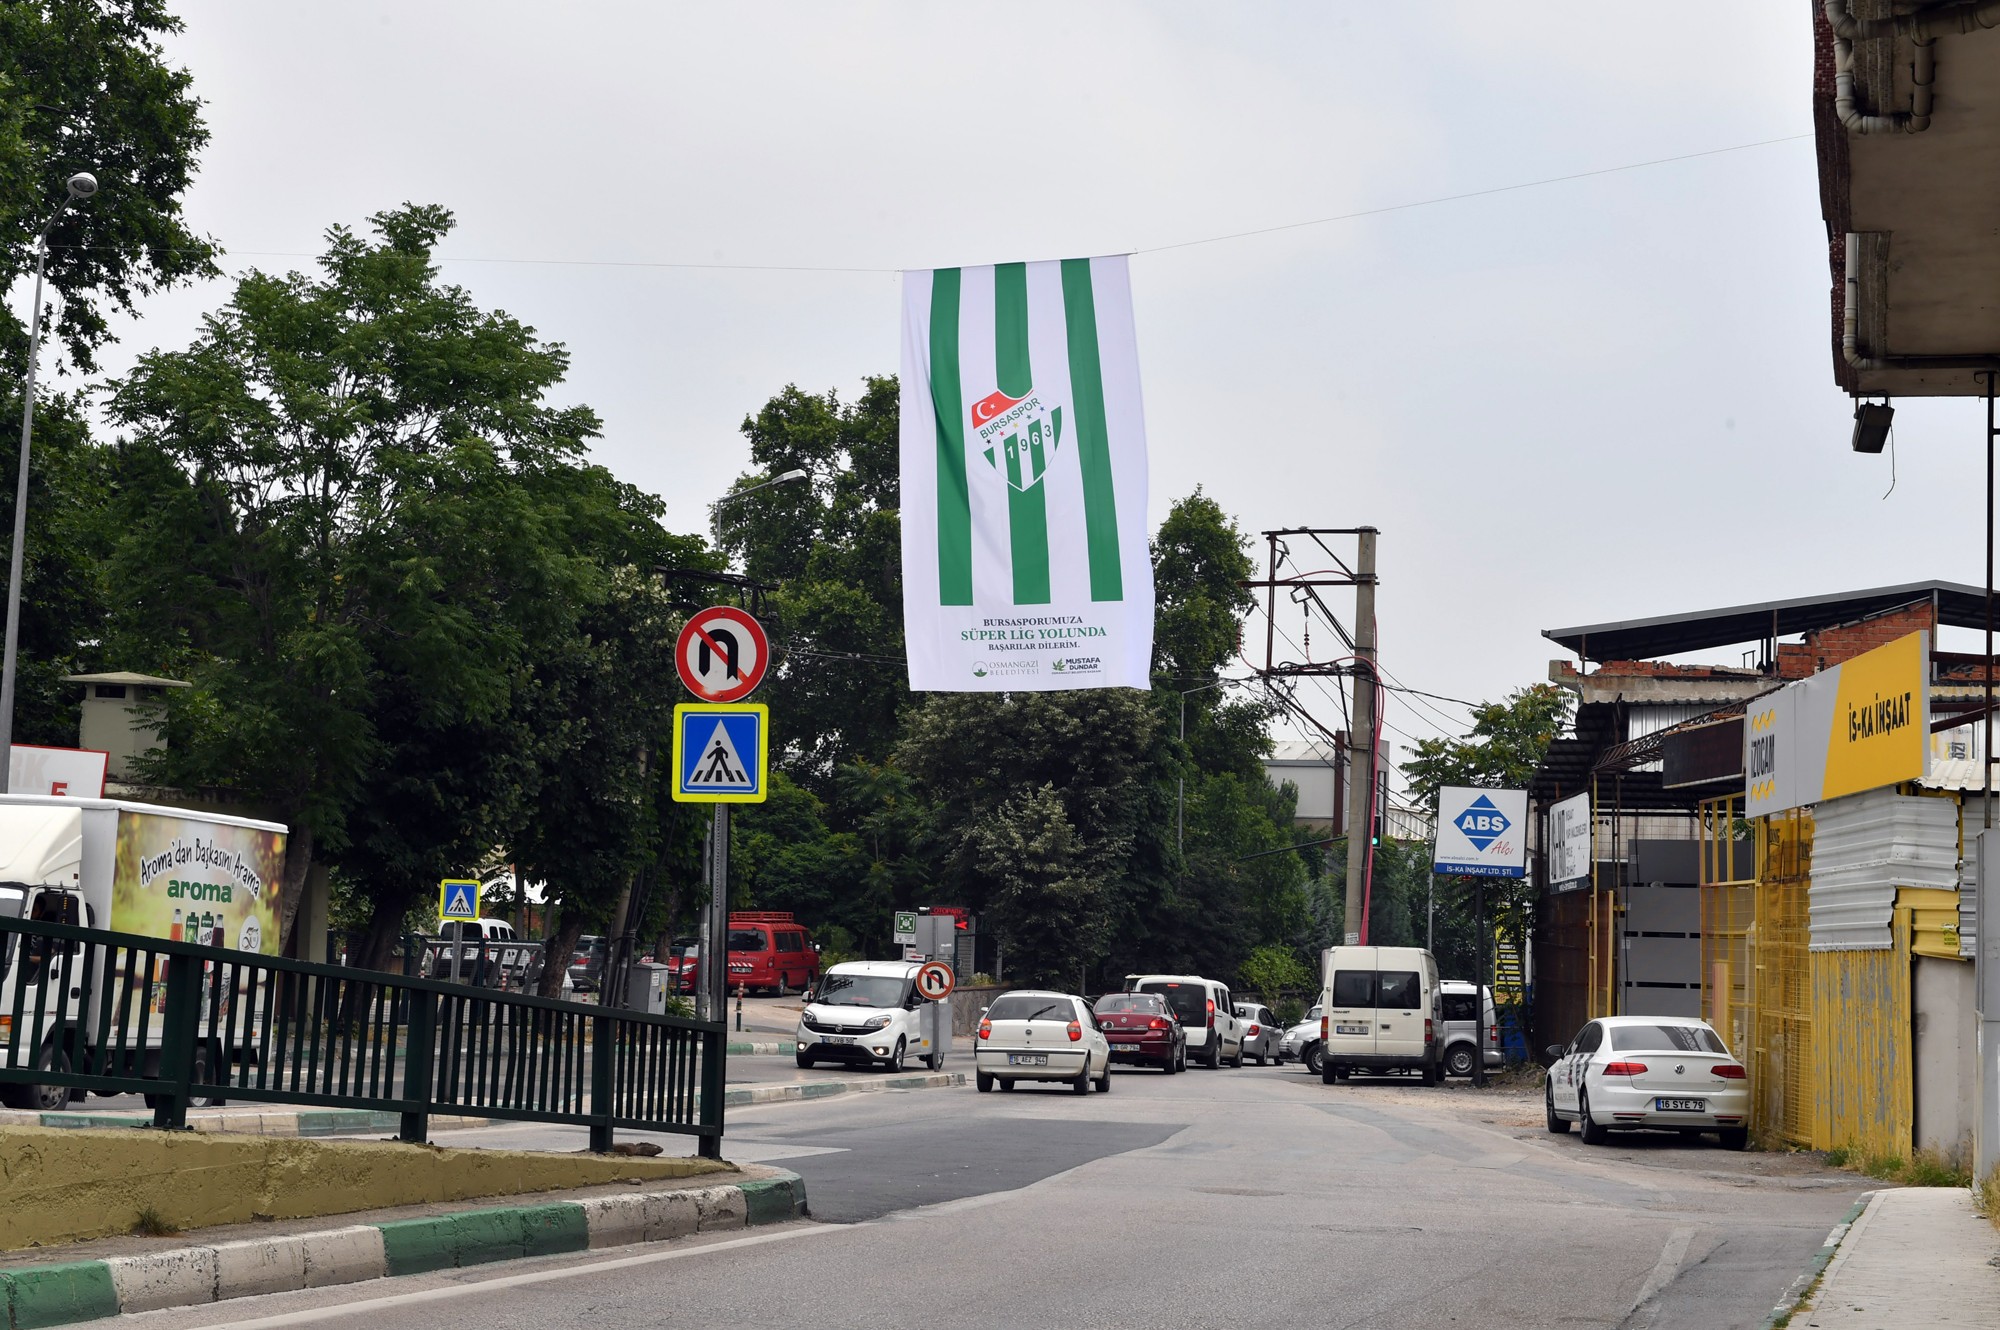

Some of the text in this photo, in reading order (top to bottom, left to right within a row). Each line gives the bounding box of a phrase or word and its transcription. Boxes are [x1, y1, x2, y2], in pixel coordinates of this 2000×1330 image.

[980, 397, 1040, 439] BURSASPOR
[1007, 425, 1052, 459] 1963
[983, 616, 1083, 627] BURSASPORUMUZA
[961, 626, 1107, 641] SÜPER LİG YOLUNDA
[988, 641, 1081, 652] BAŞARILAR DİLERİM.
[989, 660, 1039, 669] OSMANGAZİ
[1848, 692, 1911, 743] İS-KA İNŞAAT
[1461, 815, 1504, 832] ABS
[195, 838, 233, 870] Başkasını
[233, 853, 261, 897] Arama
[1446, 864, 1464, 873] İS-KA
[1465, 865, 1487, 875] İNŞAAT
[167, 880, 232, 903] aroma
[1661, 1100, 1704, 1110] 16 SYE 79
